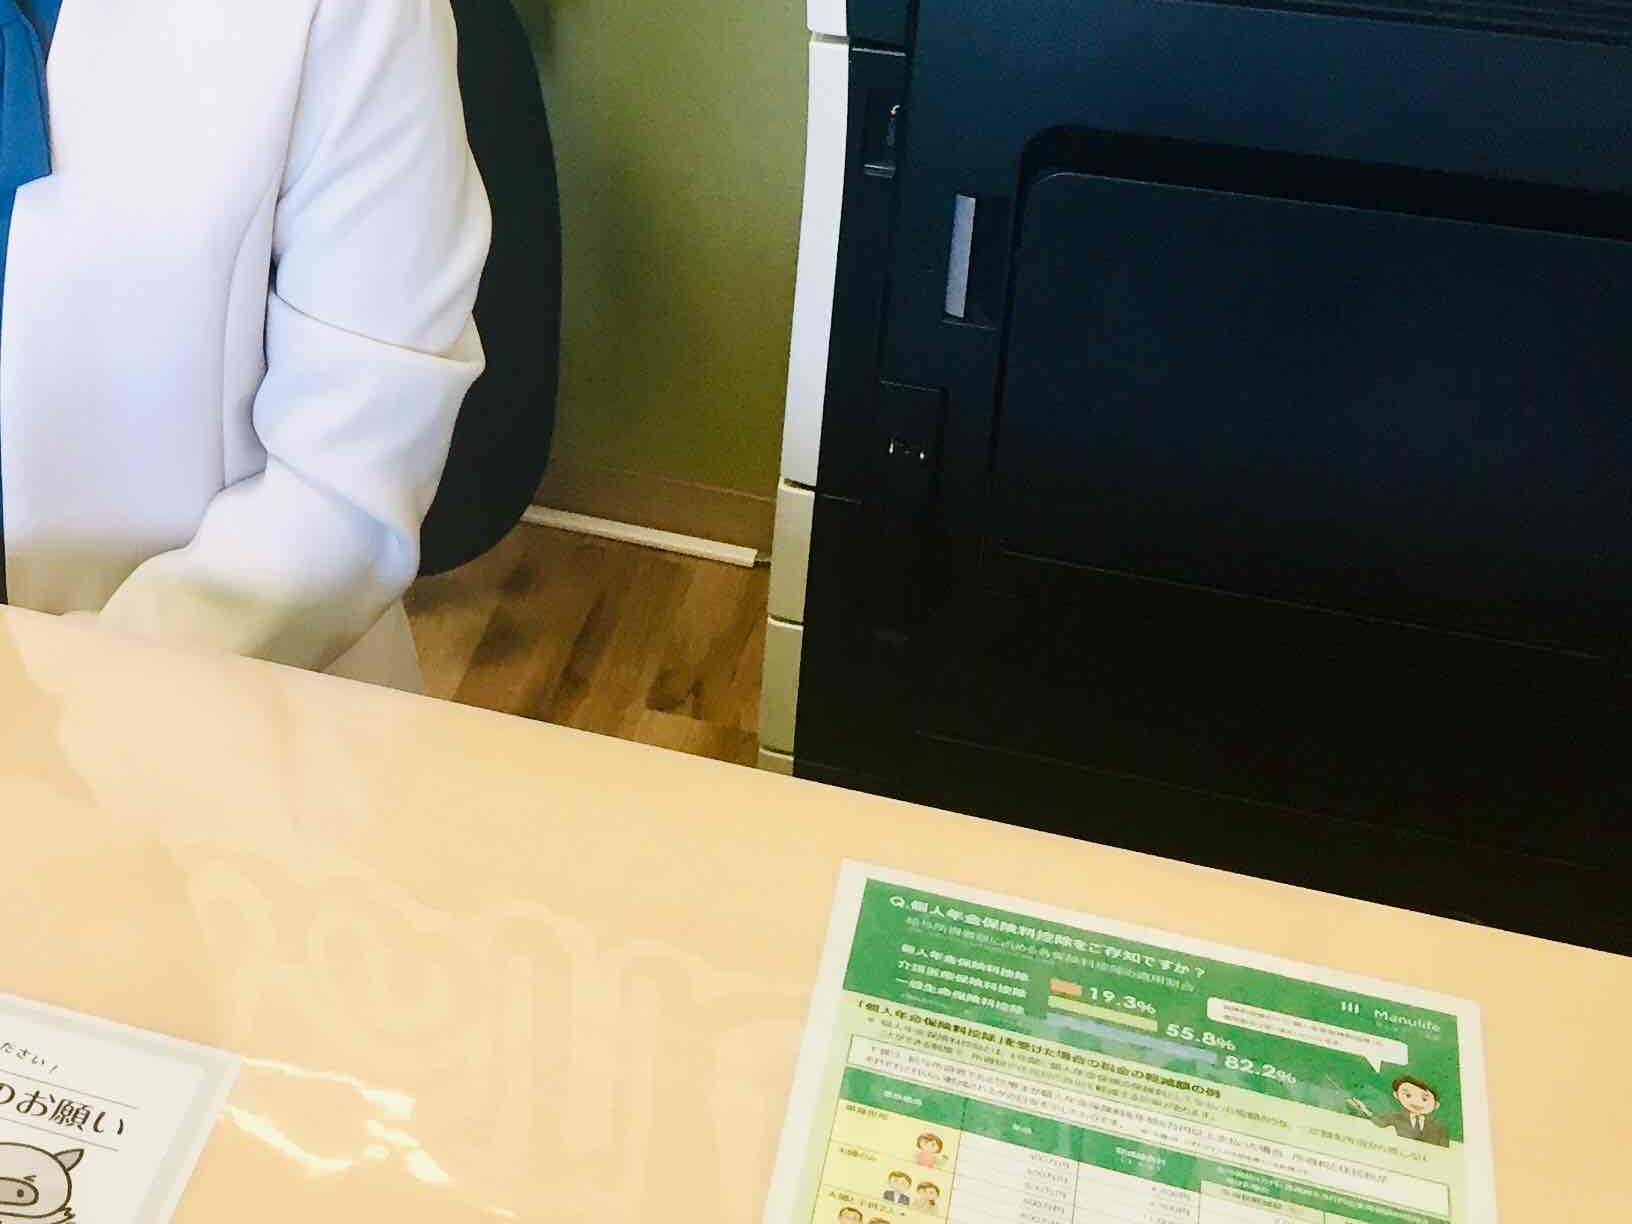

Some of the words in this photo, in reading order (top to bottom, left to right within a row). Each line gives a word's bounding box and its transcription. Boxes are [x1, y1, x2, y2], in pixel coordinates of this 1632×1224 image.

[1088, 985, 1157, 1016] 19.3%
[1373, 1008, 1442, 1033] Manulife
[1166, 1023, 1237, 1052] 55.8%
[1224, 1054, 1298, 1086] 82.2%
